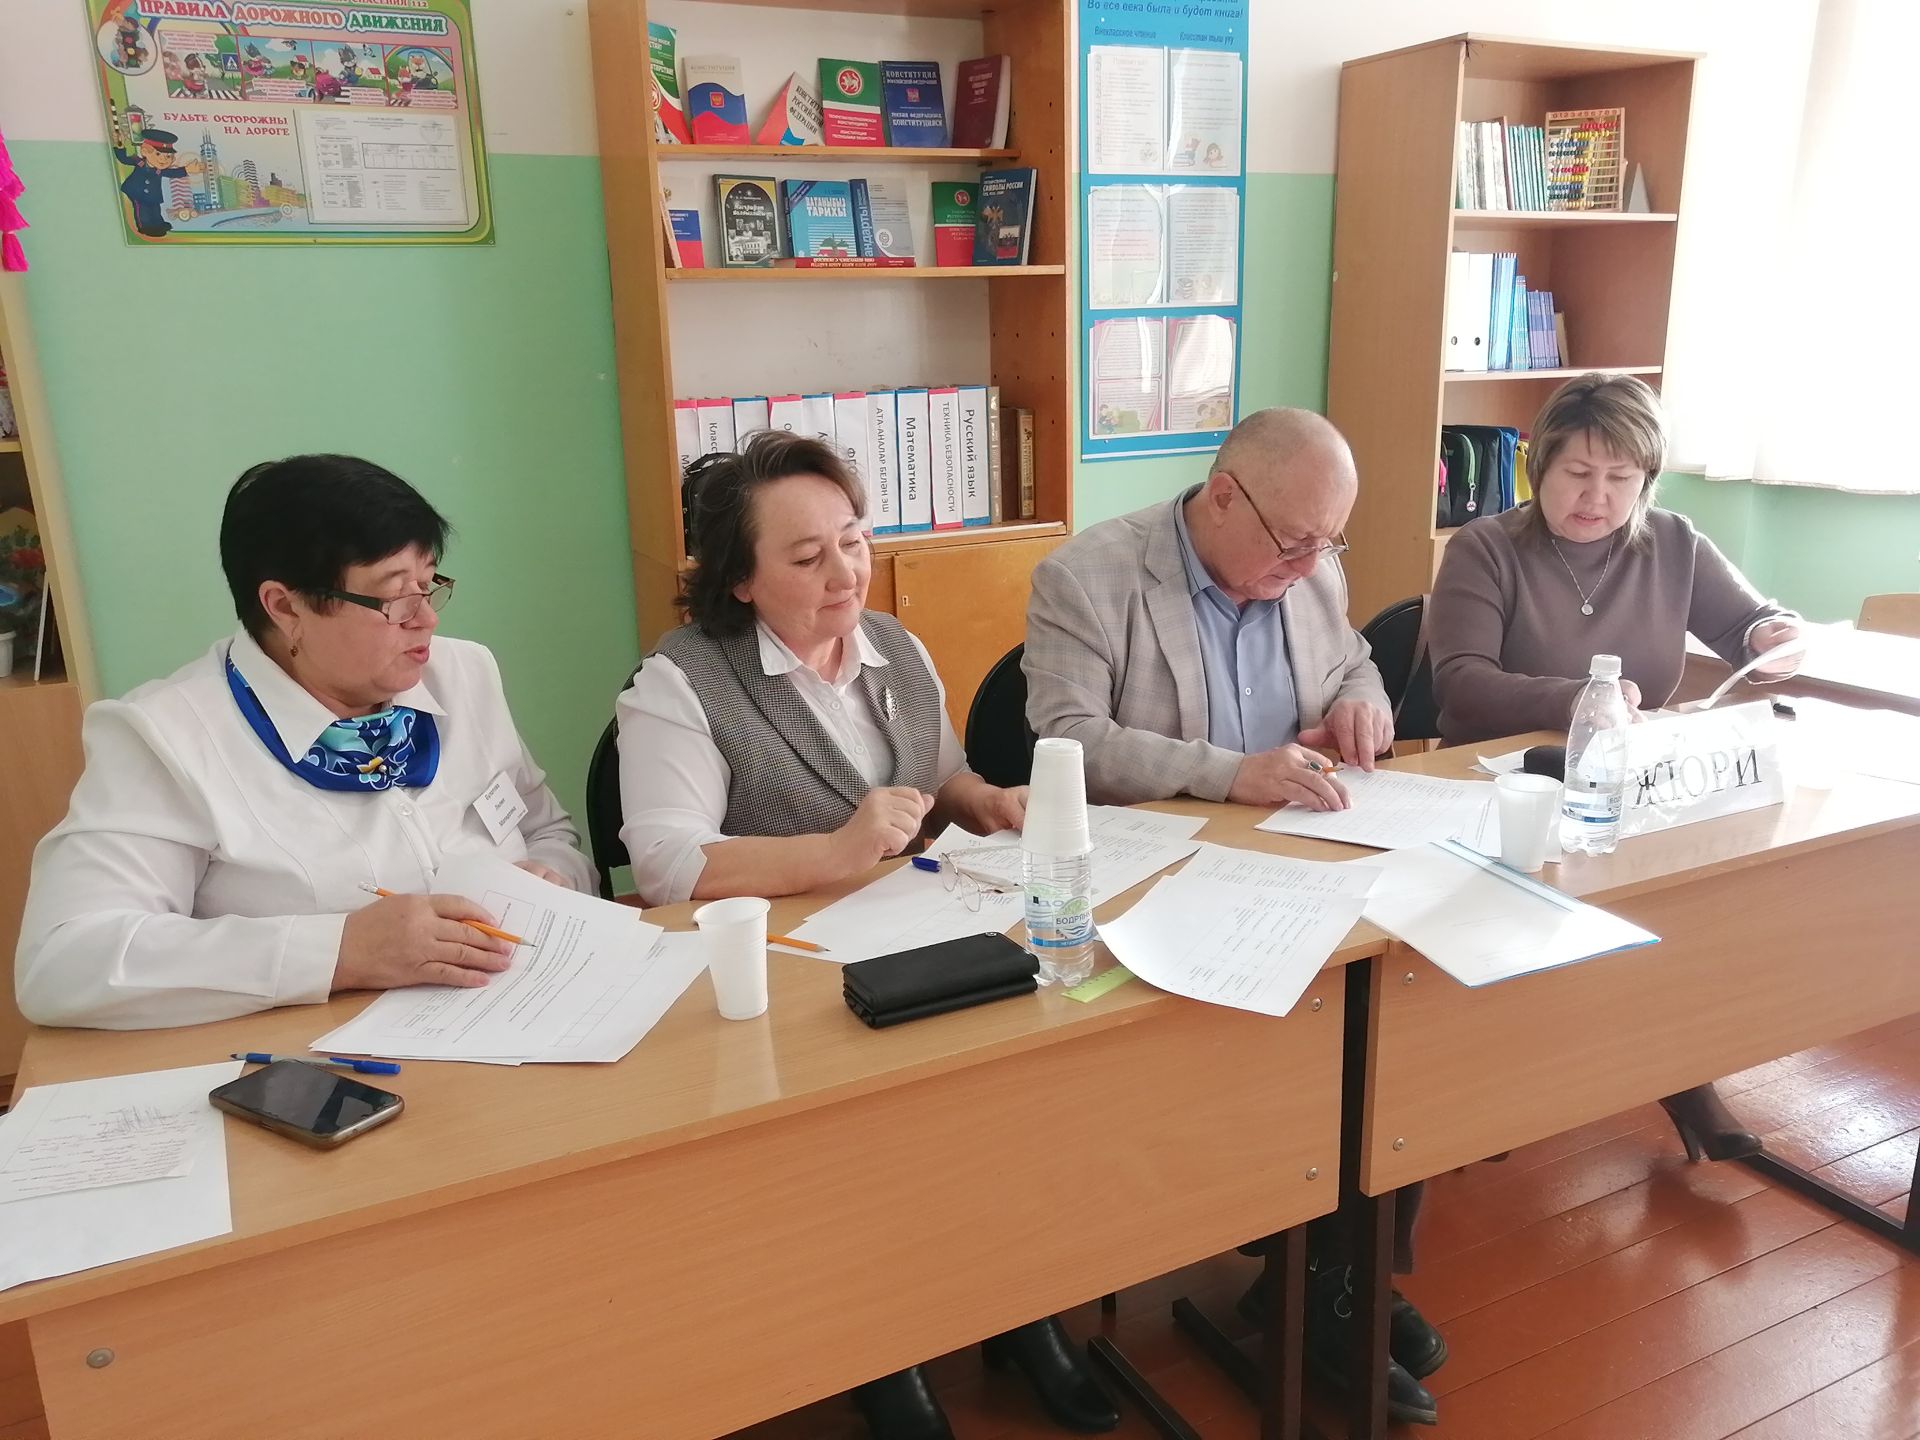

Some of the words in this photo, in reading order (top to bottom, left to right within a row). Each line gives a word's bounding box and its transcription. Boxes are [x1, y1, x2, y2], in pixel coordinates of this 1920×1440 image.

[139, 0, 228, 18] ПРАВИЛА
[235, 4, 342, 26] ДОРОЖНОГО
[350, 12, 443, 32] ДВИЖЕНИЯ
[1146, 2, 1171, 14] была
[1214, 8, 1244, 18] книга!
[163, 113, 208, 122] БУДЬТЕ
[213, 114, 288, 125] ОСТОРОЖНЫ
[246, 127, 290, 136] ДОРОГЕ
[807, 206, 847, 217] ТАРИХЫ
[876, 407, 887, 465] АТА-АНАЛАР
[943, 402, 952, 442] ТЕХНИКА
[963, 409, 977, 462] Русский
[906, 417, 917, 501] Математика
[945, 444, 955, 512] БЕЗОПАСНОСТИ
[967, 466, 976, 498] язык
[1628, 749, 1763, 809] ЖЮРИ
